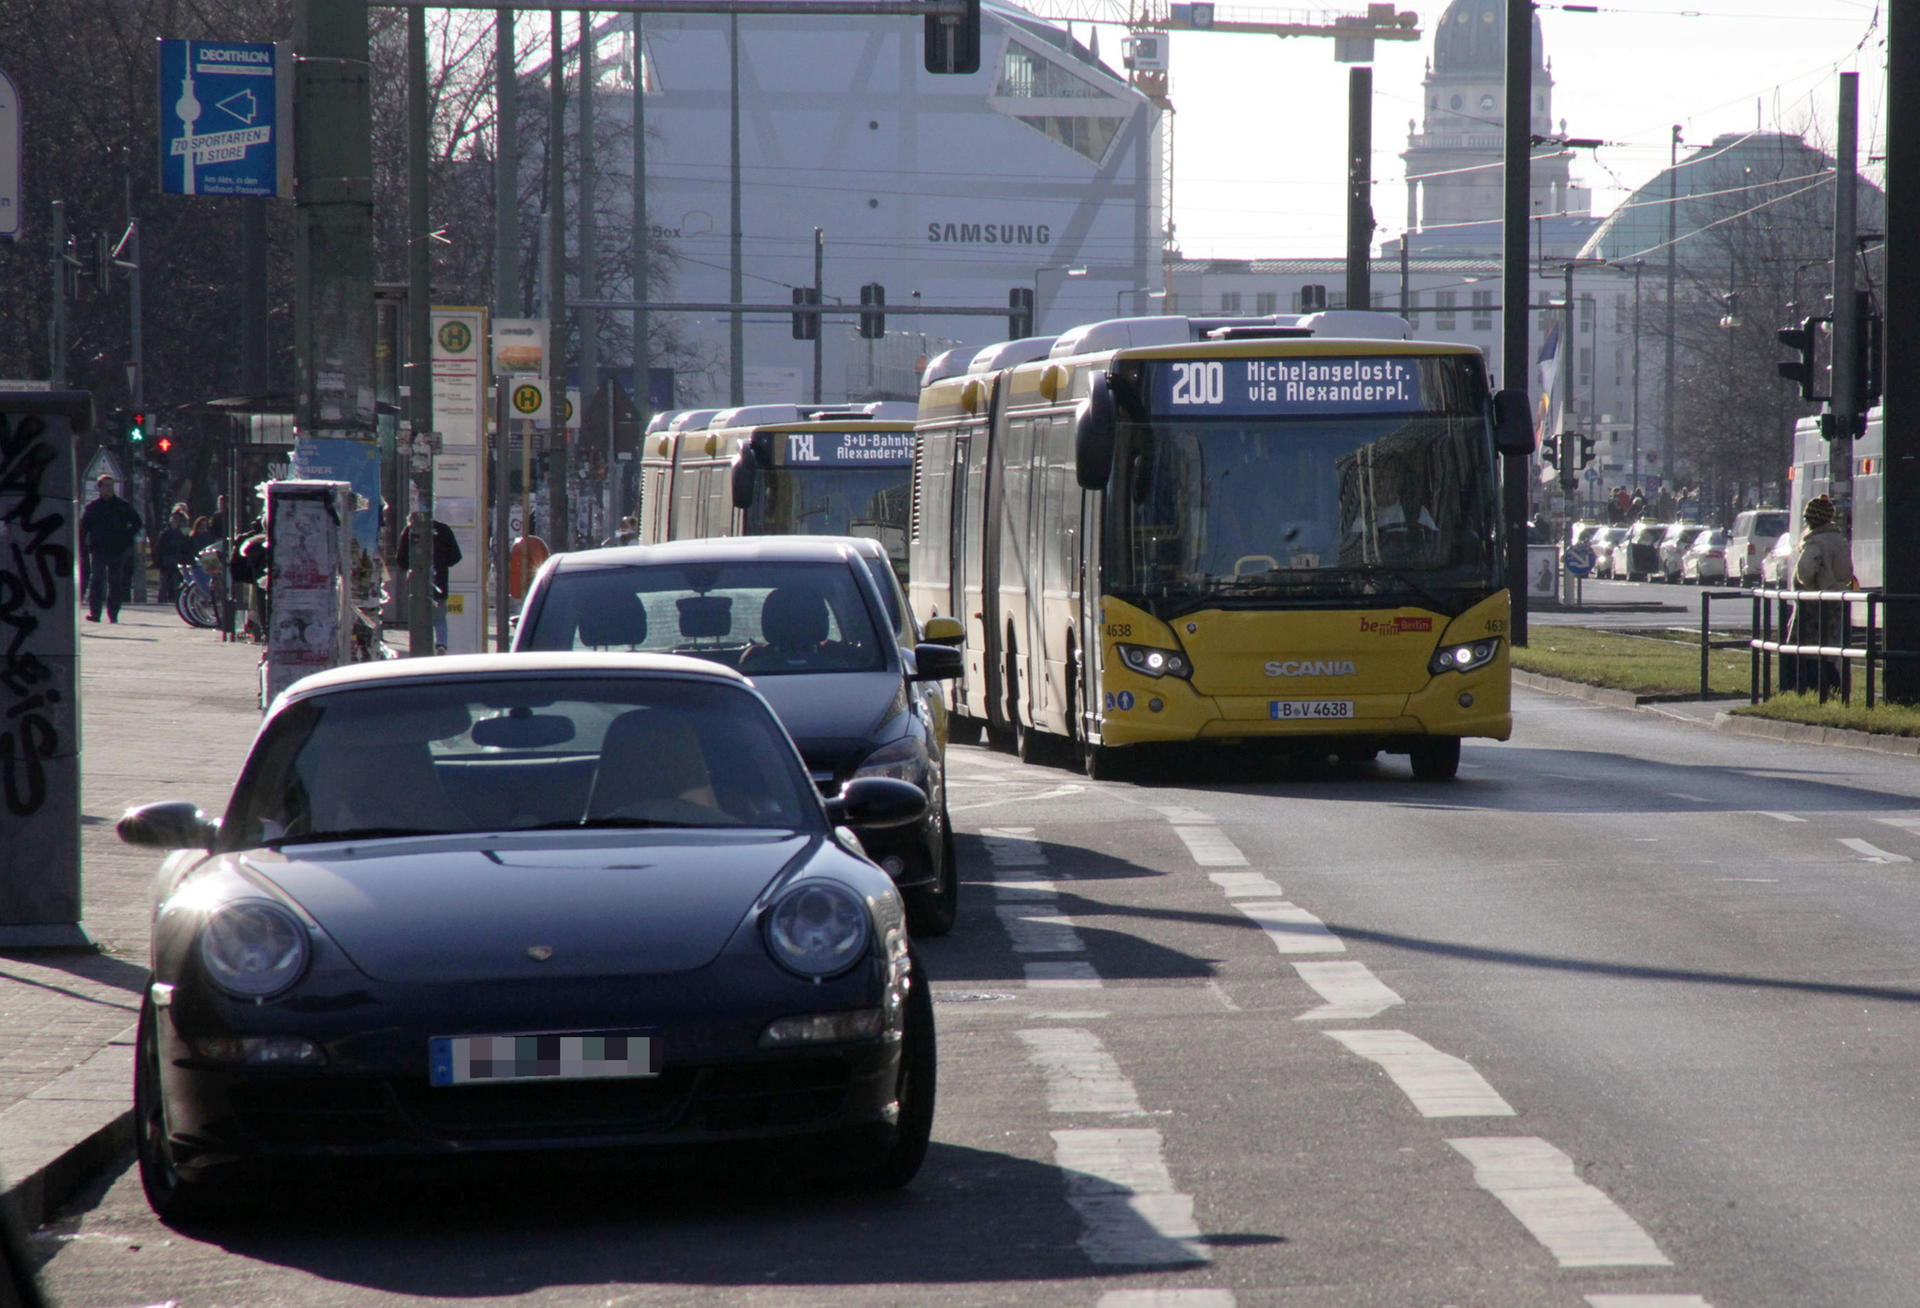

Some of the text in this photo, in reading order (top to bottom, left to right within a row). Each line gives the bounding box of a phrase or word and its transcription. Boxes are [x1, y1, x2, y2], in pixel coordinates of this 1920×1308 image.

[200, 49, 269, 63] DECATHLON
[175, 140, 188, 150] 70
[207, 147, 243, 161] STORE
[928, 222, 1050, 244] SAMSUNG
[1247, 361, 1410, 382] Michelangelostr.
[1172, 361, 1223, 404] 200
[1249, 381, 1408, 401] via Alexanderpl.
[520, 390, 536, 408] H
[789, 434, 820, 461] TXL
[1107, 624, 1132, 637] 4638
[1264, 660, 1357, 677] SCANIA
[1283, 702, 1348, 717] B V 4638
